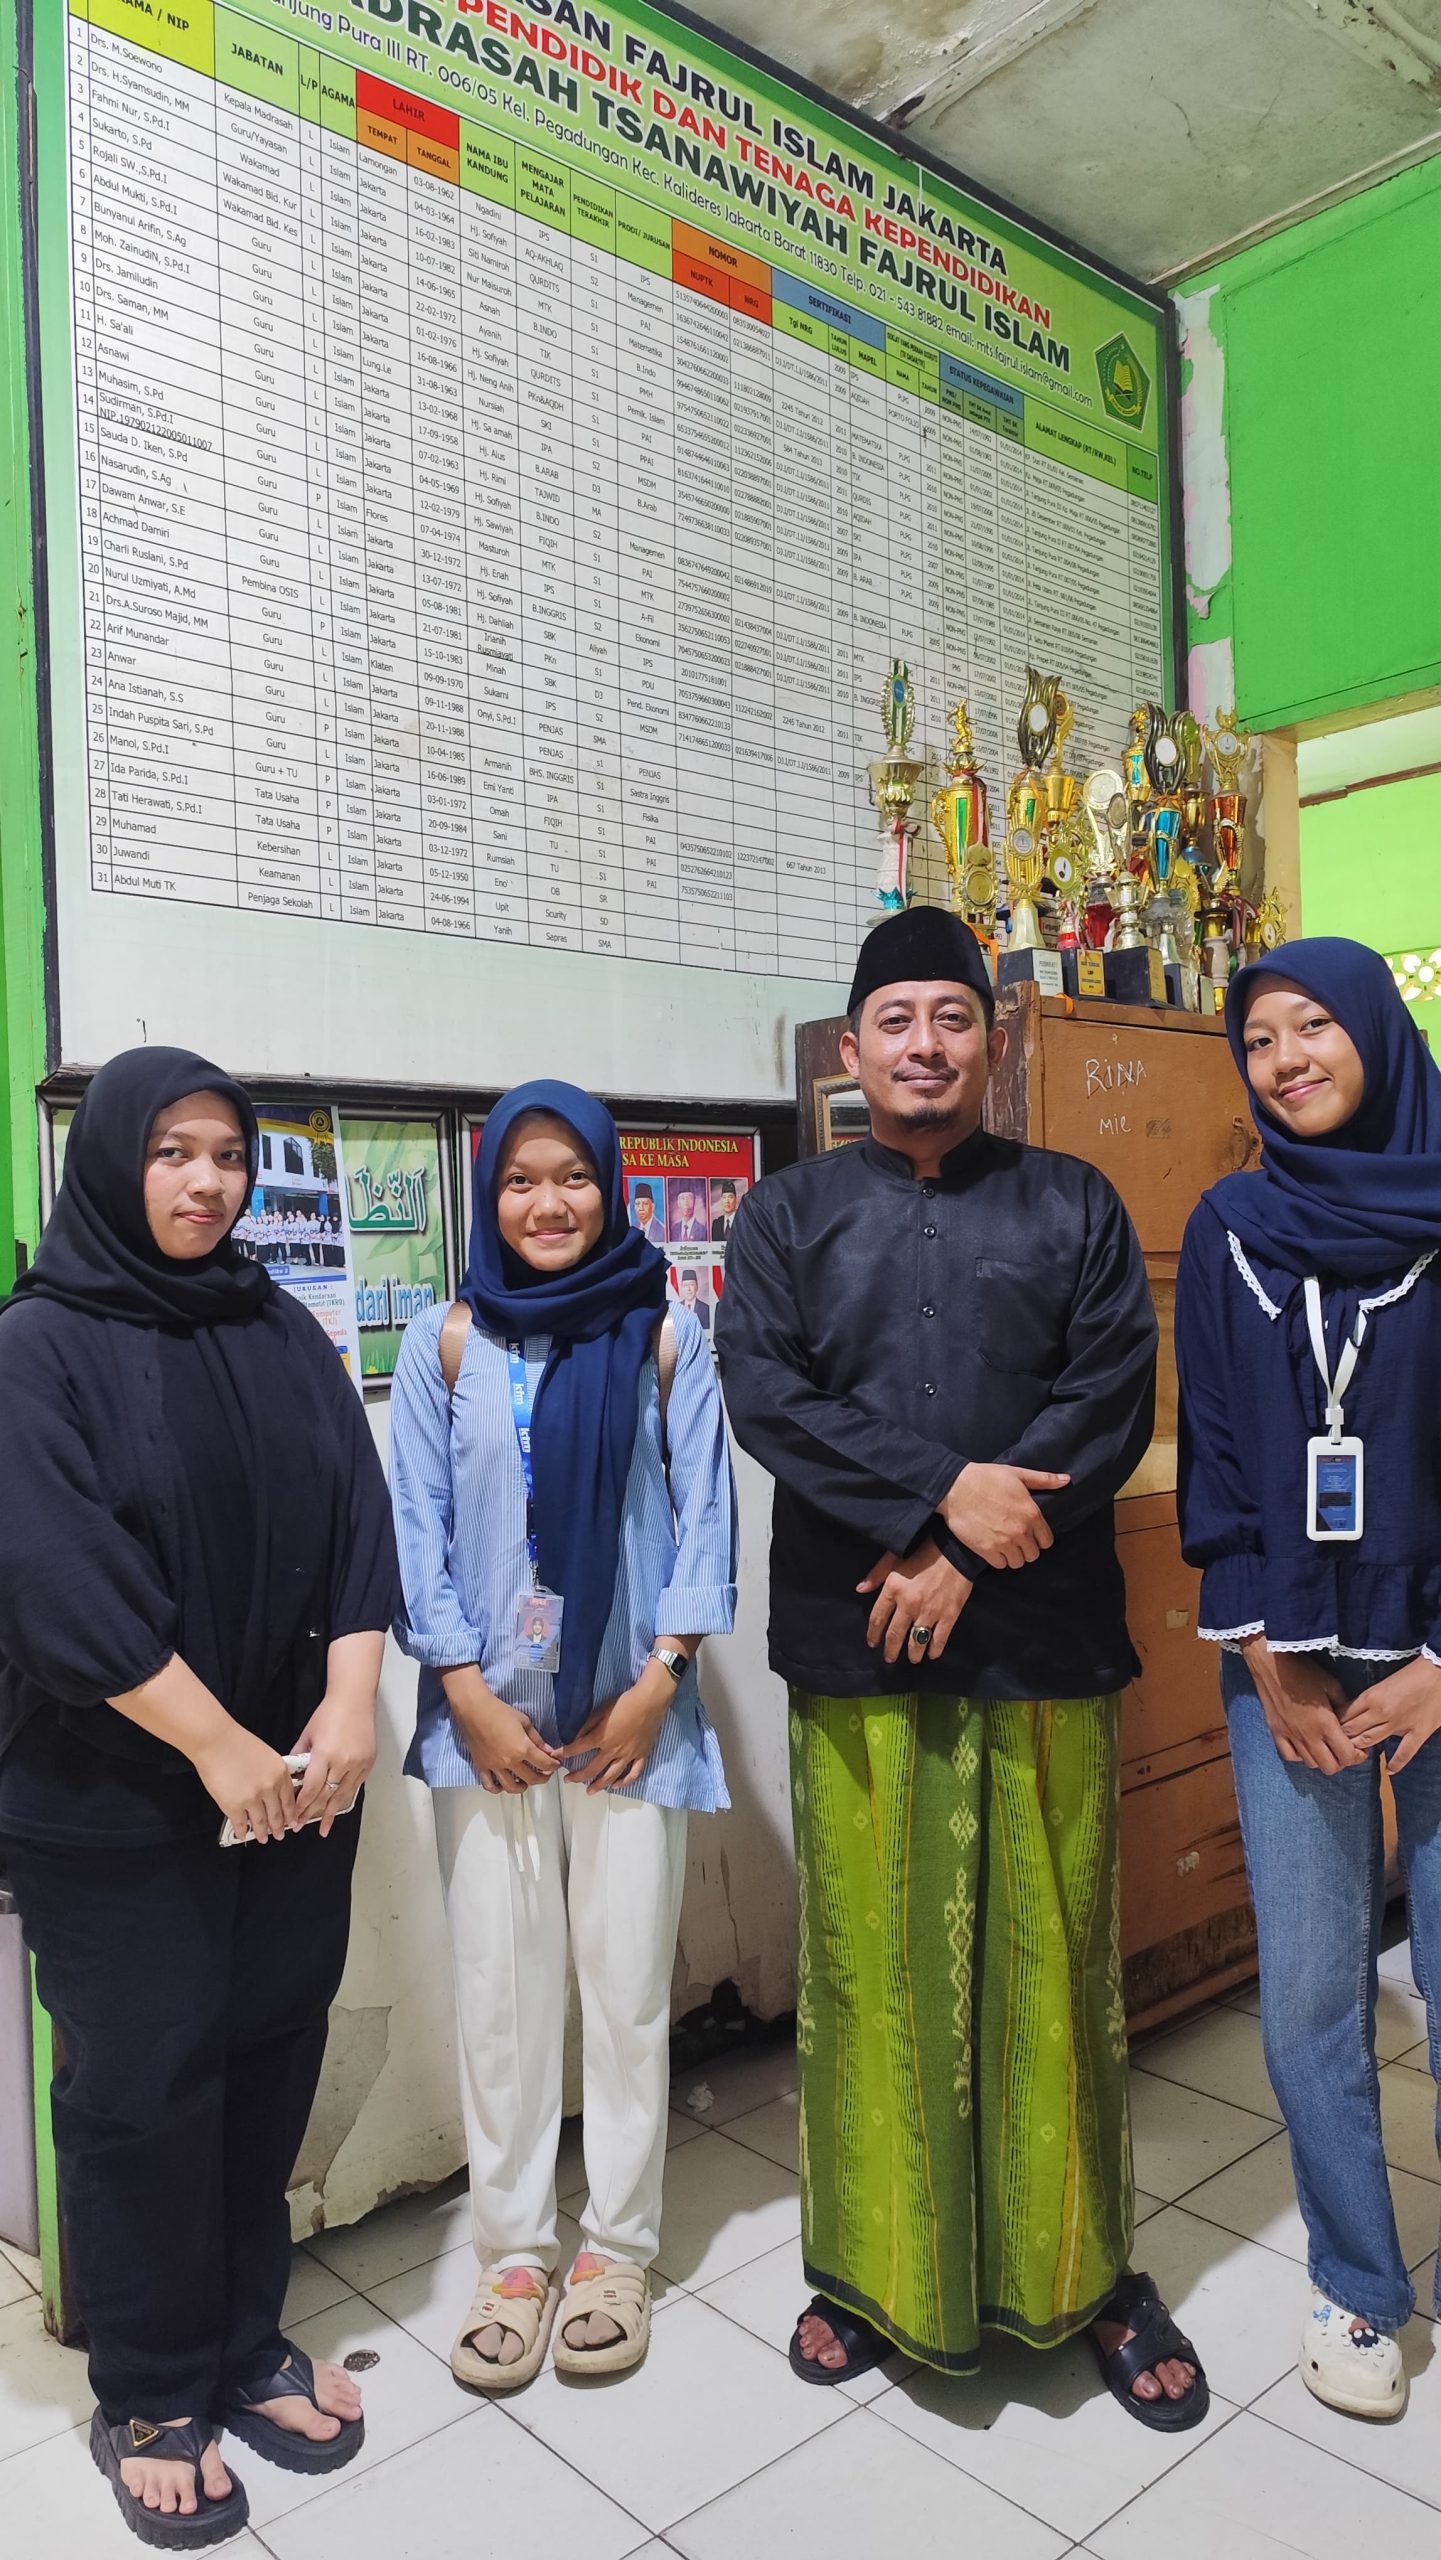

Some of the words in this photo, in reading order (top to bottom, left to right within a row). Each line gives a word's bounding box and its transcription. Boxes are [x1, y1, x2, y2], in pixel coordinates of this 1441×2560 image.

[167, 12, 189, 33] NIP
[90, 33, 108, 49] Drs.
[111, 42, 162, 73] M.Soewono
[231, 41, 283, 77] JABATAN
[91, 61, 109, 77] Drs.
[112, 70, 172, 106] H.Syamsudin,
[174, 97, 189, 112] MM
[300, 73, 317, 92] L/P
[321, 83, 355, 110] AGAMA
[224, 92, 252, 113] Kepala
[254, 105, 293, 130] Madrasah
[392, 97, 425, 123] LAHIR
[230, 122, 287, 154] Guru/Yayasan
[367, 124, 397, 146] TEMPAT
[92, 145, 118, 164] Rojali
[120, 157, 167, 184] SW.,S.Pd.I
[359, 152, 397, 176] Lamongan
[417, 146, 451, 170] TANGGAL
[466, 142, 490, 162] NAMA
[493, 154, 508, 170] IBU
[626, 42, 761, 135] FAJRUL
[773, 121, 873, 197] ISLAM
[883, 184, 1006, 275] JAKARTA
[338, 14, 381, 51] Pura
[387, 37, 400, 61] III
[406, 47, 432, 75] RT.
[438, 65, 496, 105] 006/05
[502, 92, 529, 122] Kel.
[535, 108, 628, 170] Pegadungan
[632, 157, 659, 185] Kec.
[664, 173, 721, 216] Kalideres
[725, 205, 770, 241] Jakarta
[774, 230, 806, 261] Barat
[809, 251, 837, 276] 11830
[840, 265, 865, 291] Telp.
[869, 283, 885, 302] 021
[897, 296, 914, 316] 543
[917, 307, 943, 331] 81882
[946, 324, 974, 347] email:
[467, 156, 508, 185] KANDUNG
[521, 159, 563, 188] MENGAJAR
[343, 0, 578, 114] DRASAH
[594, 87, 848, 255] TSANAWIYAH
[859, 237, 976, 325] FAJRUL
[985, 309, 1071, 373] ISLAM
[413, 175, 454, 200] 03-08-1962
[532, 179, 553, 197] MATA
[475, 201, 501, 220] Ngadini
[520, 187, 565, 217] PELAJARAN
[573, 193, 613, 219] PENDIDIKAN
[653, 93, 725, 148] DAN
[736, 134, 855, 221] TENAGA
[865, 205, 1051, 328] KEPENDIDIKAN
[94, 201, 135, 226] Bunyanul
[137, 219, 164, 238] Arifin,
[166, 229, 186, 248] S.Ag
[577, 206, 609, 229] TERAKHIR
[470, 224, 481, 237] Hj.
[482, 229, 507, 246] Sofiyah
[618, 219, 640, 237] PRODI/
[643, 231, 670, 251] JURUSAN
[94, 229, 116, 246] Moh.
[119, 238, 161, 265] ZainudiN,
[164, 256, 190, 274] S.Pd.I
[708, 245, 737, 268] NOMOR
[690, 269, 712, 288] NUPTK
[627, 291, 663, 313] Managemen
[744, 295, 758, 309] NRG
[808, 295, 850, 324] SERTIFIKASI
[799, 321, 812, 335] NRG
[97, 342, 129, 362] Asnawi
[417, 351, 457, 373] 16-08-1966
[858, 350, 877, 367] MAPEL
[99, 391, 144, 417] Sudirman,
[147, 407, 173, 424] S.Pd.I
[102, 482, 136, 501] Dawam
[137, 493, 168, 512] Anwar,
[171, 503, 185, 516] S.E
[365, 507, 388, 523] Flores
[103, 539, 129, 554] Charli
[131, 546, 166, 566] Ruslani,
[169, 556, 188, 570] S.Pd
[478, 540, 509, 557] Masturoh
[241, 575, 277, 593] Pembina
[278, 585, 299, 599] OSIS
[106, 594, 162, 617] Drs.A.Suroso
[164, 609, 191, 626] Majid,
[193, 616, 208, 628] MM
[532, 603, 567, 621] B.INGGRIS
[370, 659, 393, 672] Klaten
[109, 706, 135, 720] Indah
[138, 712, 170, 727] Puspita
[172, 719, 192, 733] Sari,
[194, 723, 214, 736] S.Pd
[538, 722, 563, 736] PENJAS
[426, 745, 465, 762] 10-04-1985
[111, 790, 129, 802] Tati
[131, 793, 173, 811] Herawati,
[176, 800, 202, 814] S.Pd.I
[630, 788, 648, 799] Sastra
[649, 791, 670, 804] Inggris
[257, 840, 301, 856] Kebersihan
[114, 874, 140, 886] Abdul
[142, 877, 161, 889] Muti
[163, 880, 176, 891] TK
[247, 891, 280, 906] Penjaga
[282, 896, 312, 908] Sekolah
[430, 916, 470, 930] 04-08-1966
[545, 908, 567, 921] Scurity
[620, 1136, 675, 1151] REPUBLIK
[677, 1138, 739, 1152] INDONESIA
[622, 1153, 637, 1166] SA
[640, 1153, 655, 1167] KE
[657, 1153, 690, 1167] MASA
[355, 1279, 389, 1322] dari
[392, 1278, 434, 1321] iman
